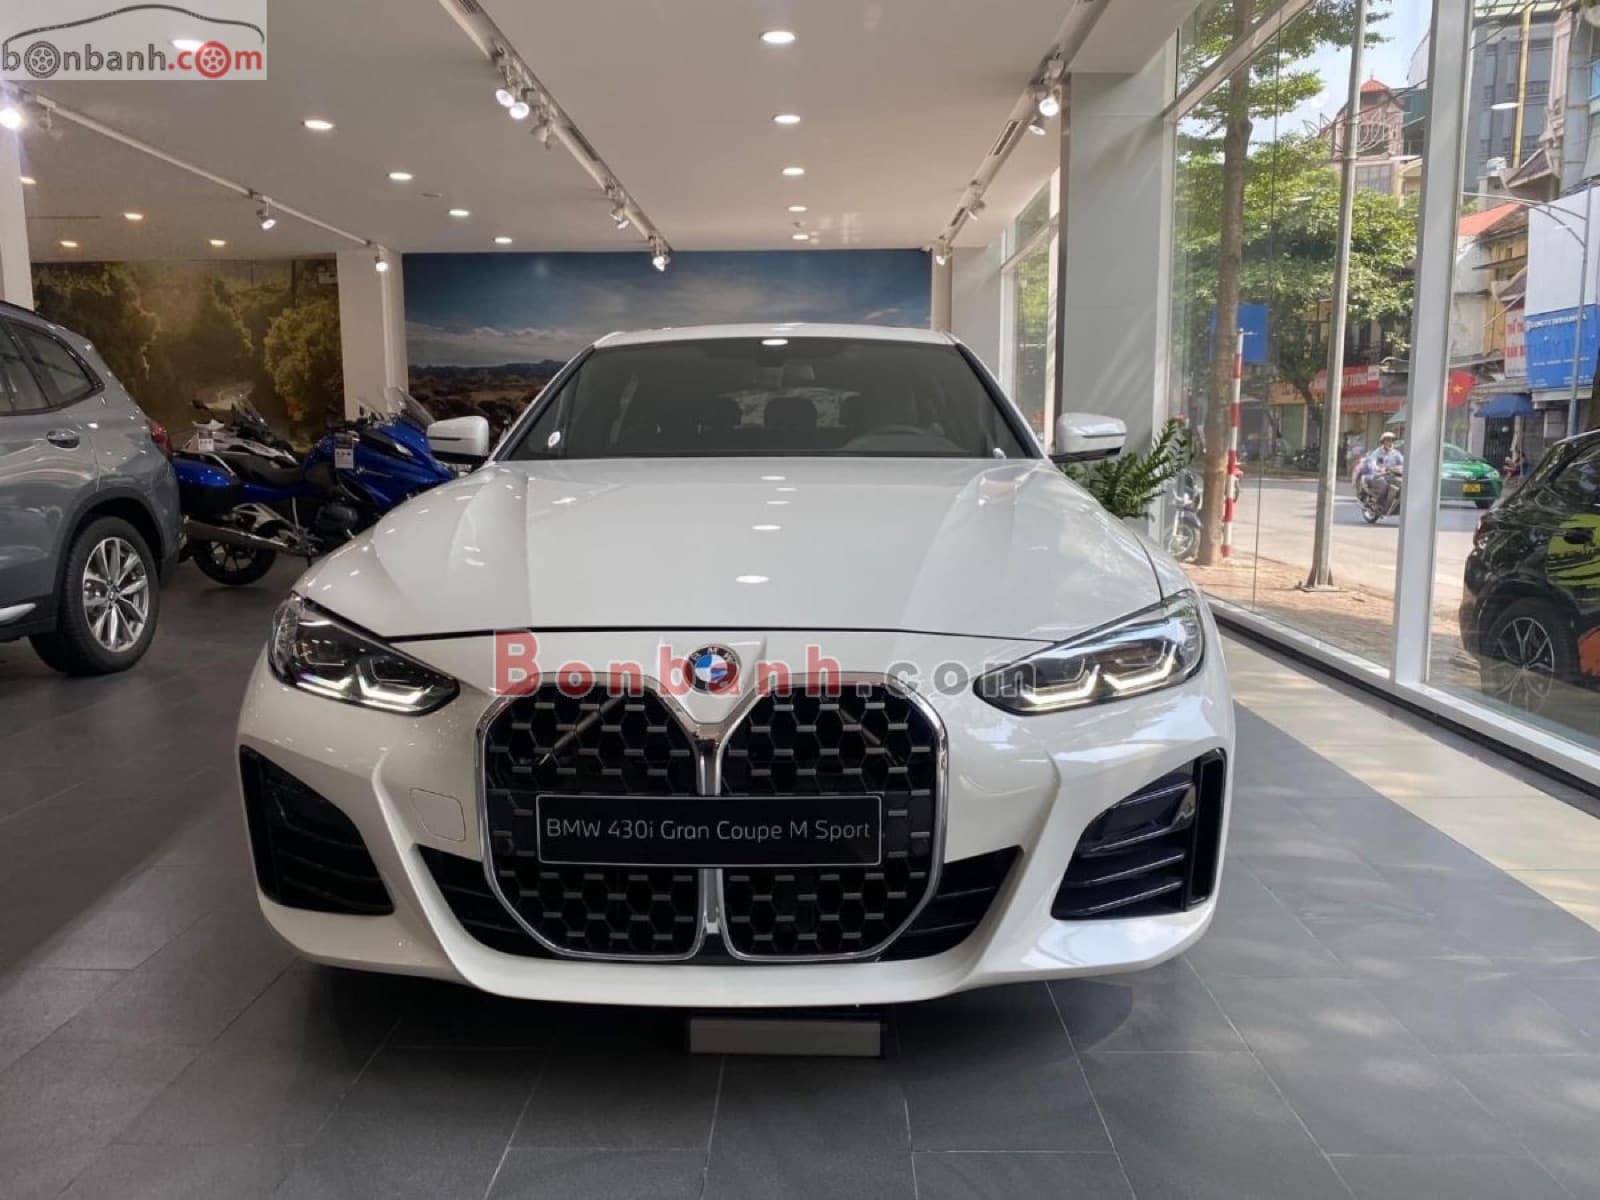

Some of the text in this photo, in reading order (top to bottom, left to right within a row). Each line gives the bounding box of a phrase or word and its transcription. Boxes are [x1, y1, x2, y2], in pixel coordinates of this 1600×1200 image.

[546, 819, 871, 843] BMW 430i Gran Coupe M Sport
